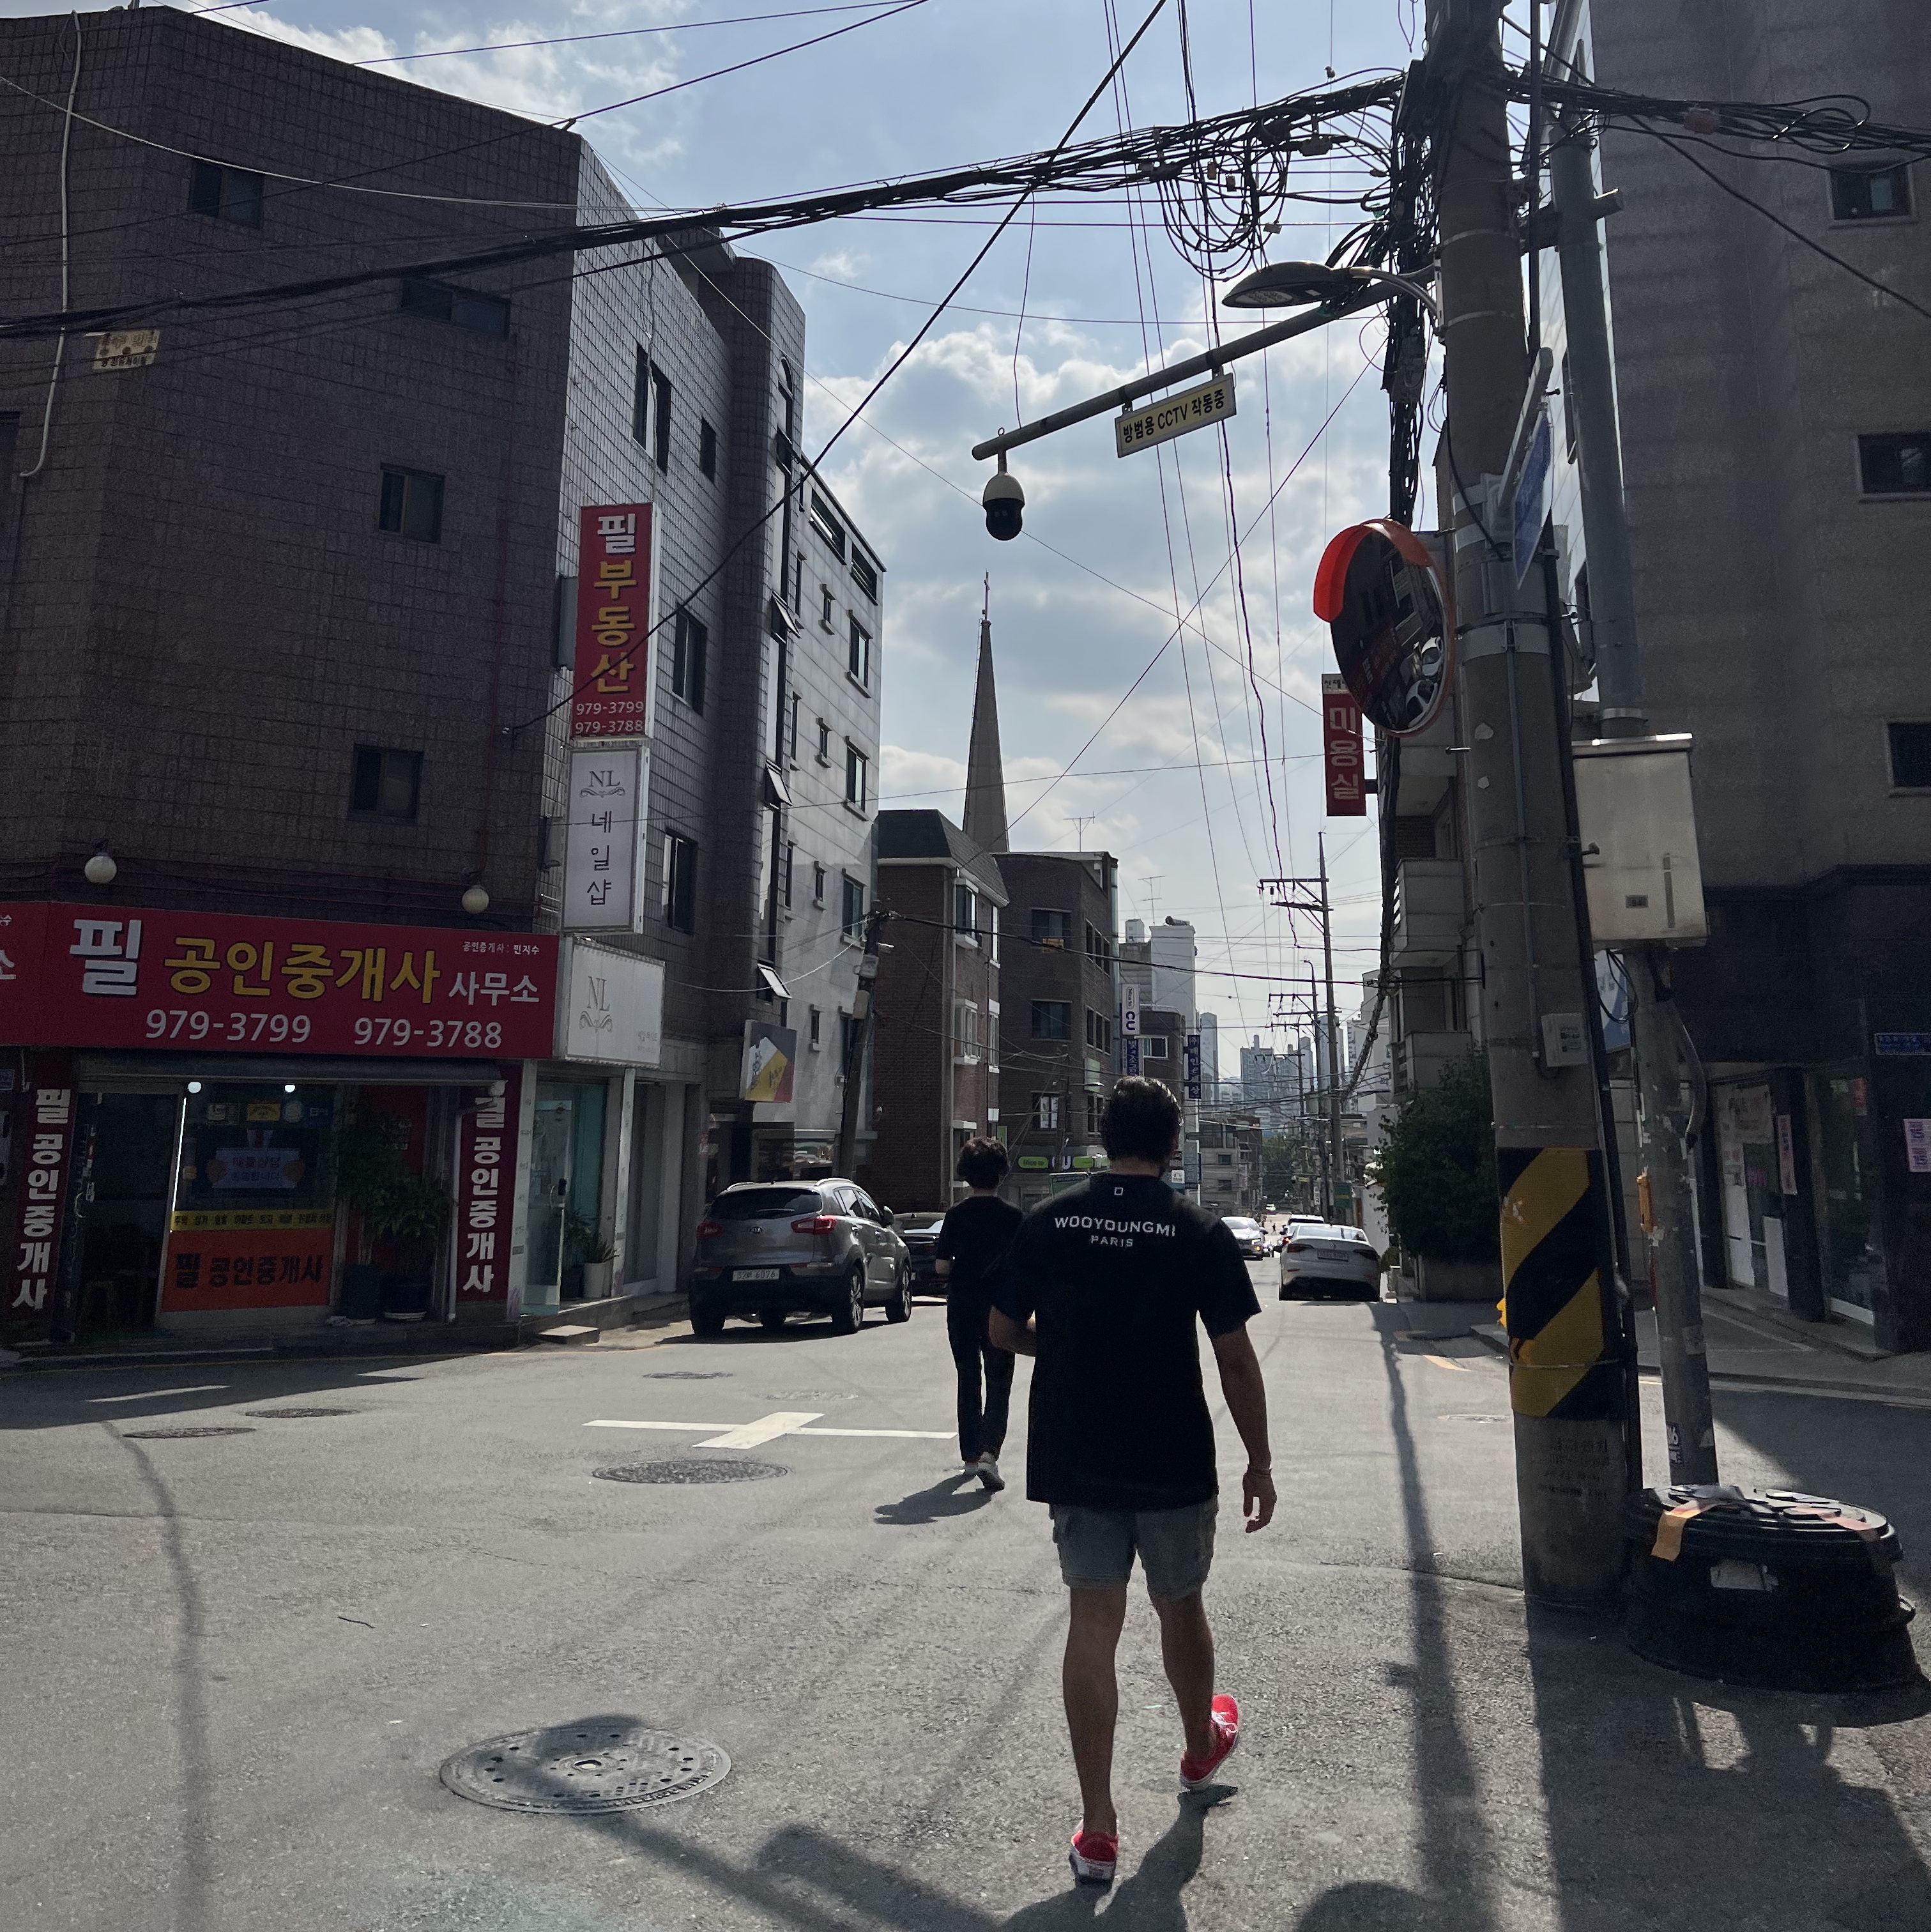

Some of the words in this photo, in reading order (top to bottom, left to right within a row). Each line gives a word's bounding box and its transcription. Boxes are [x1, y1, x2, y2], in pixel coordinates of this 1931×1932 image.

[1123, 417, 1154, 443] 방범용
[1157, 403, 1187, 429] CCTV
[1191, 388, 1225, 416] 작동중
[597, 514, 636, 553] 필
[590, 560, 636, 694] 부동산
[576, 701, 645, 715] 979-3799
[575, 720, 643, 734] 979-3788
[1329, 707, 1359, 799] 미용실
[588, 770, 620, 788] NL
[586, 809, 613, 906] 네일샵
[70, 919, 142, 996] 필
[164, 937, 441, 1003] 공인중개사
[448, 971, 540, 1006] 사무소
[513, 944, 540, 955] 민지수
[587, 976, 611, 1012] NL
[146, 1009, 312, 1043] 979-3799
[353, 1016, 503, 1049] 979-3788
[1126, 1011, 1136, 1031] CU
[35, 1088, 72, 1124] 필
[11, 1133, 64, 1310] 공인중개사
[462, 1136, 501, 1292] 공인중개사
[1054, 1215, 1176, 1237] WOOYOUNGMI
[1090, 1234, 1134, 1248] PARIS
[176, 1254, 201, 1289] 필
[210, 1254, 323, 1287] 공인중개사
